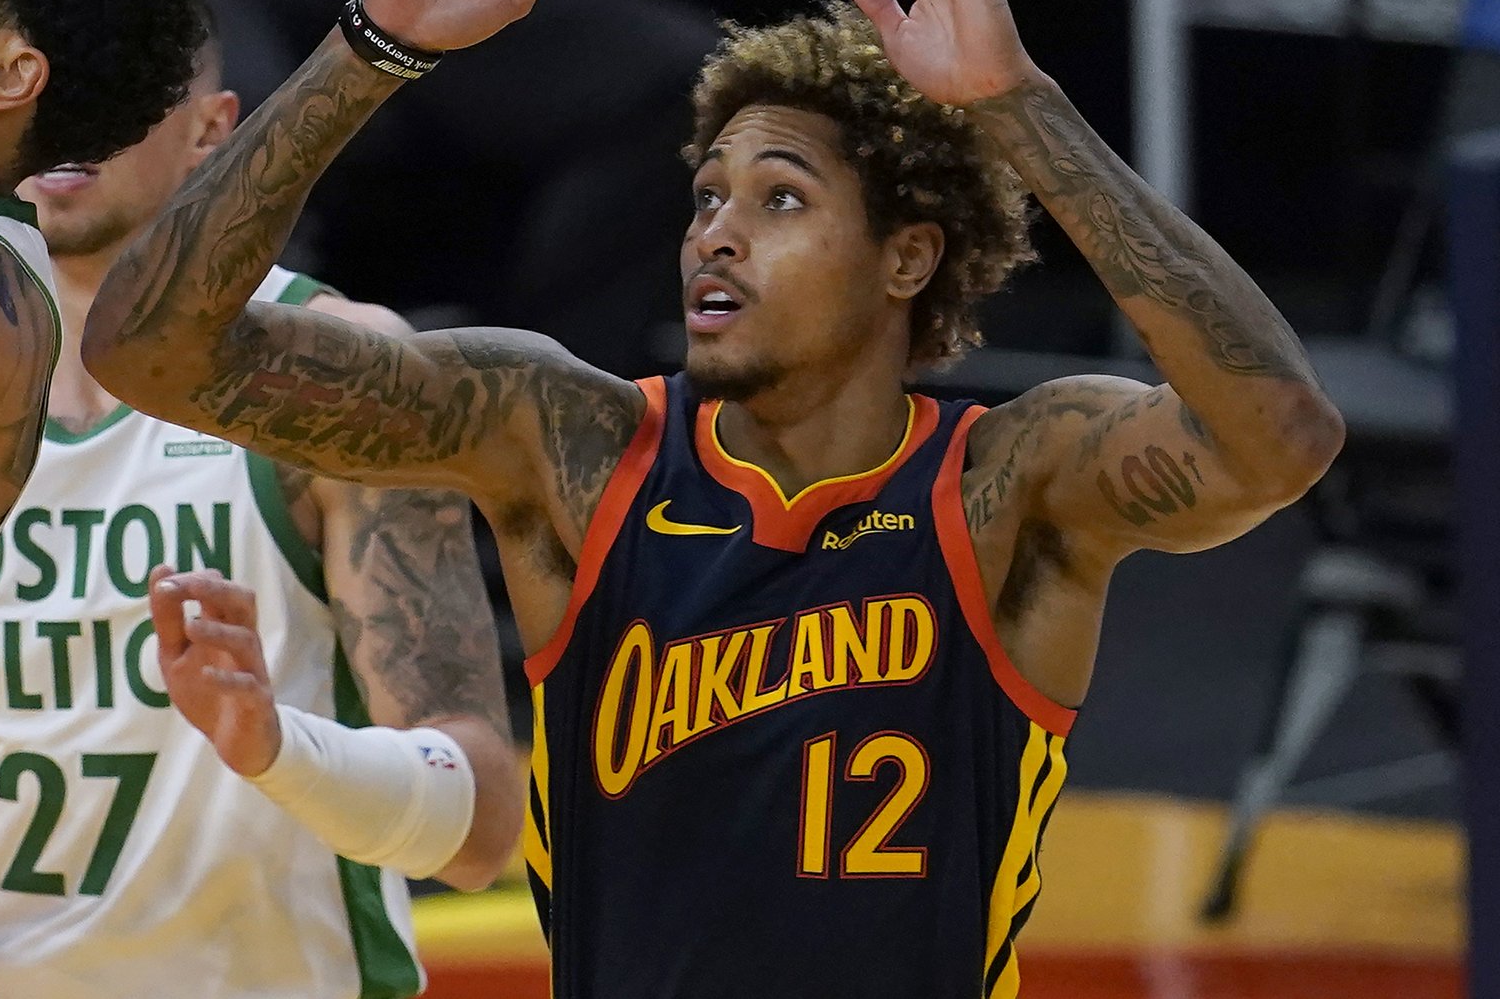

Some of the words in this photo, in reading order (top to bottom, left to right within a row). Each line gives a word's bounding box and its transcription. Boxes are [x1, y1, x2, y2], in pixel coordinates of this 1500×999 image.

[364, 27, 415, 71] Everyone
[591, 593, 940, 800] OAKLAND
[796, 730, 932, 880] 12
